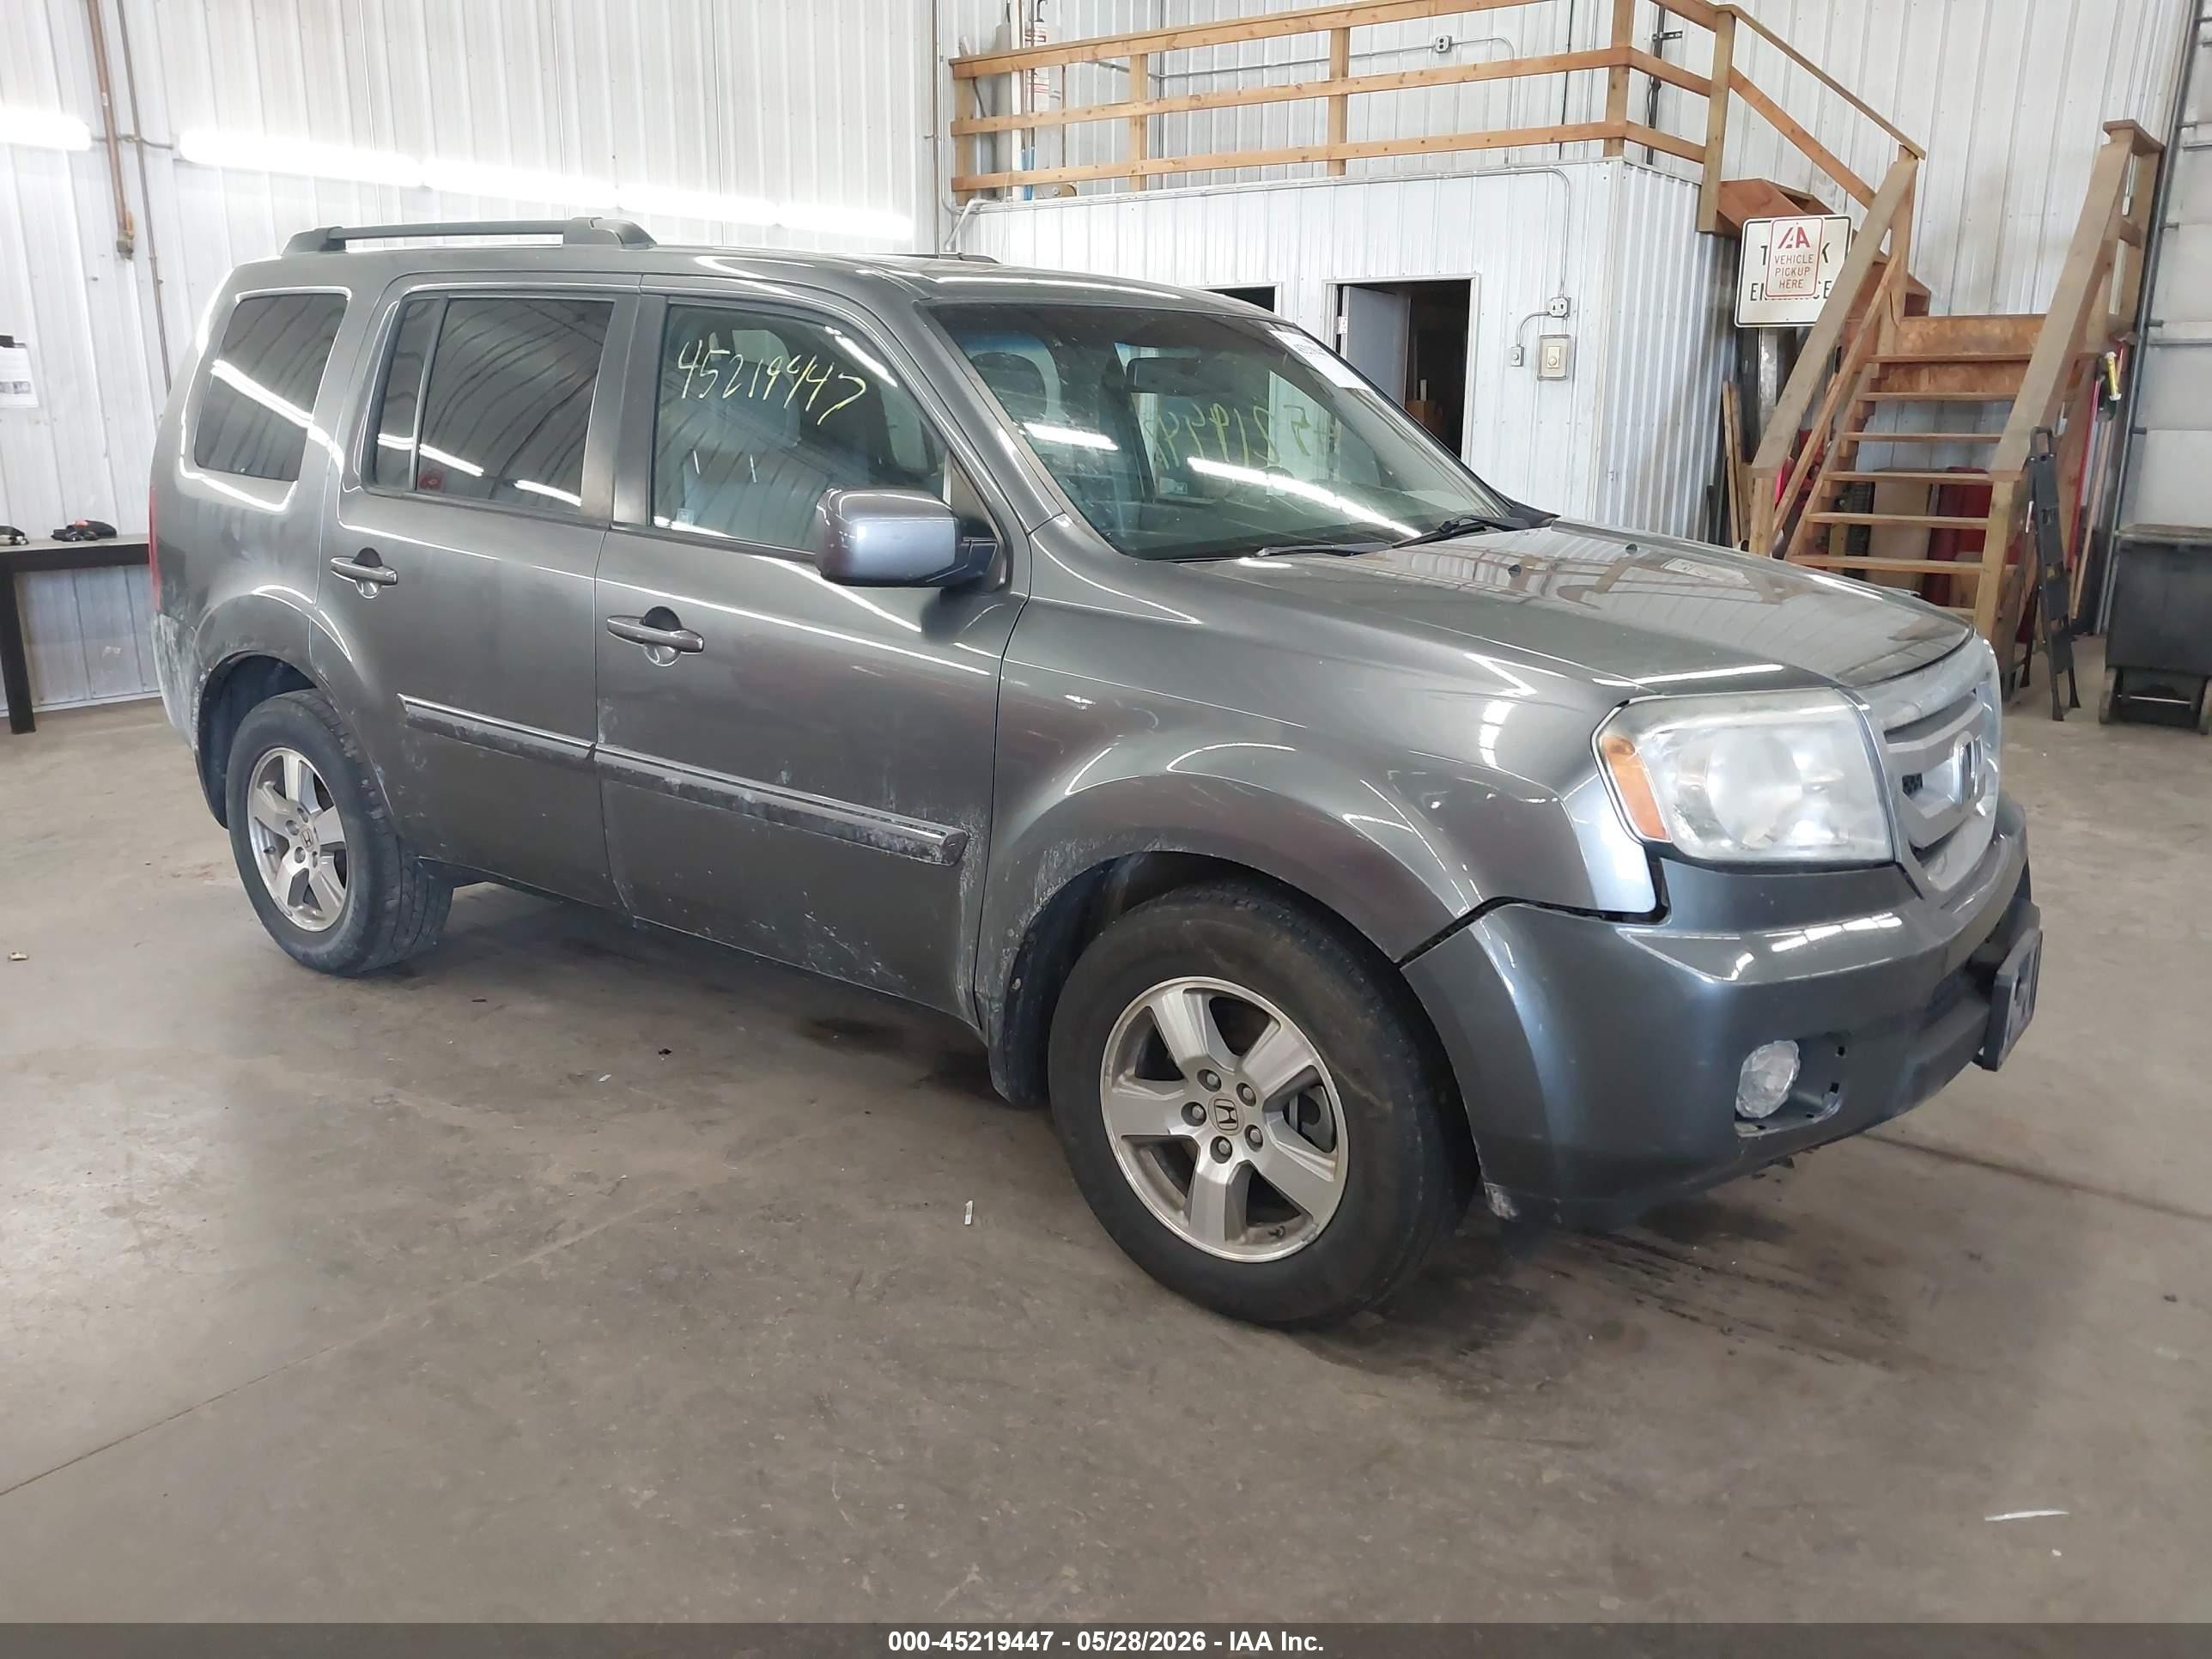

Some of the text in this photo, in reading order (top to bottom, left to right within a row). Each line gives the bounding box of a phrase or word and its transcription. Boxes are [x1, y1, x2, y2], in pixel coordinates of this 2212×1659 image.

[1774, 253, 1814, 265] VEHICLE
[1774, 266, 1811, 277] PICKUP
[1778, 278, 1805, 289] HERE
[677, 339, 867, 427] 45219447
